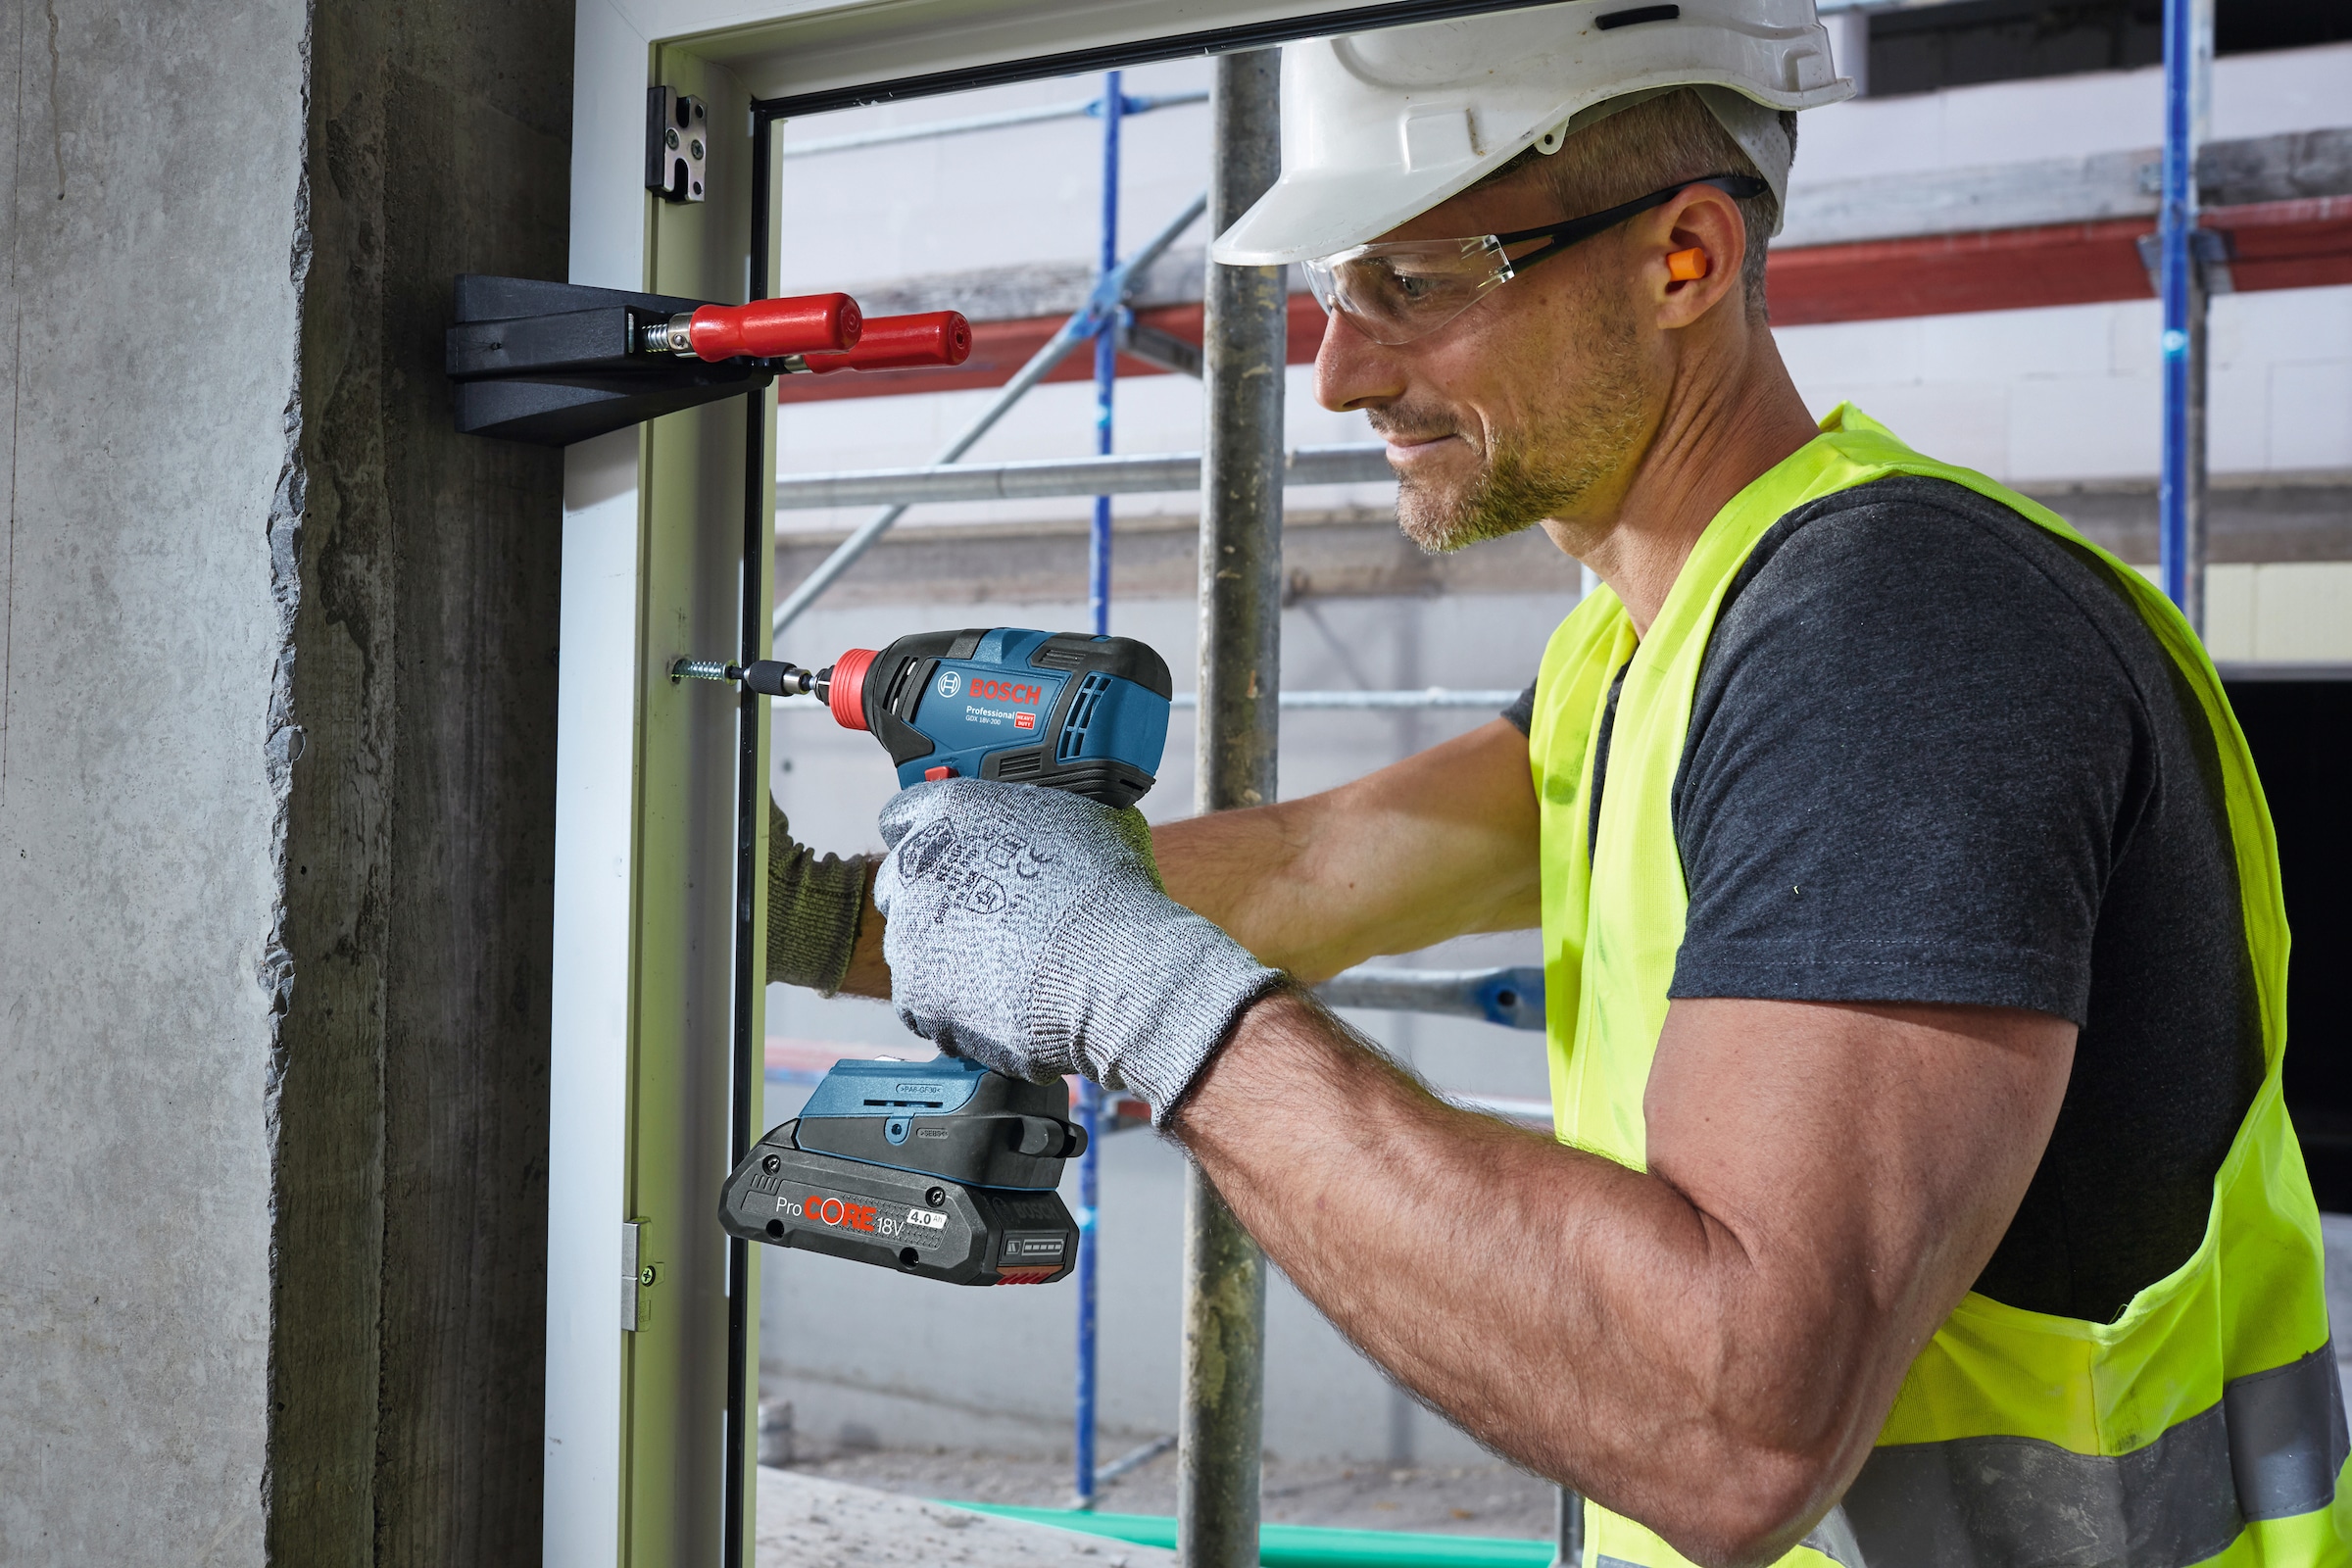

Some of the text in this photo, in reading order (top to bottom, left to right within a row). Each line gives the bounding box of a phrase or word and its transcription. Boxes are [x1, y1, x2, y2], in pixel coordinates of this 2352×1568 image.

[969, 678, 1042, 705] BOSCH
[966, 706, 1014, 719] Professional
[979, 716, 1002, 726] 18V-200
[910, 1210, 943, 1225] 4.0 Ah
[1011, 1201, 1061, 1220] BOSCH
